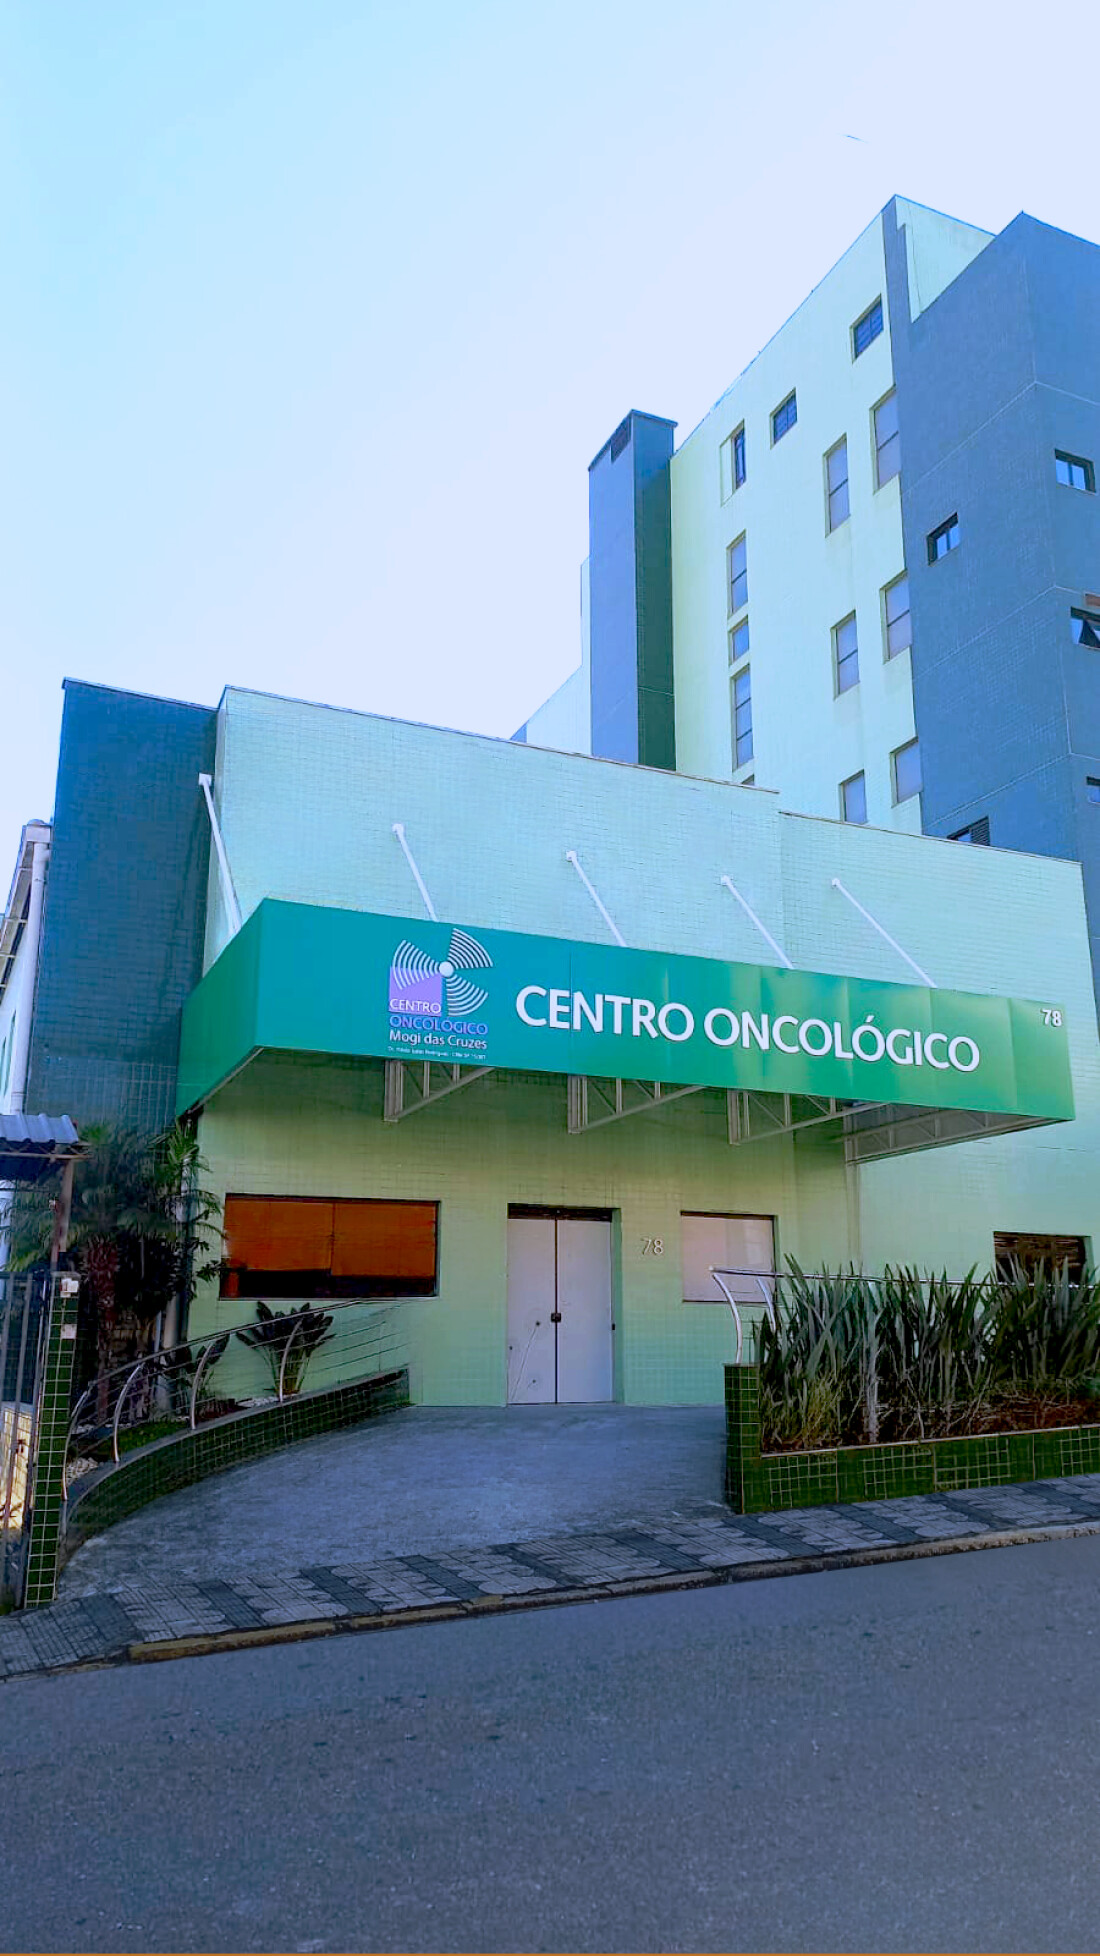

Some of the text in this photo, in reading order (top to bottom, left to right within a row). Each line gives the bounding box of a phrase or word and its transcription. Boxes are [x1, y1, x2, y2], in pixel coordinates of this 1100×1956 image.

[390, 998, 441, 1014] CENTRO
[389, 1016, 488, 1035] ONCOLÓGICO
[1041, 1008, 1063, 1027] 78
[515, 985, 981, 1073] CENTRO ONCOLÓGICO
[389, 1029, 488, 1050] Mogi das Cruzes
[640, 1235, 664, 1256] 78
